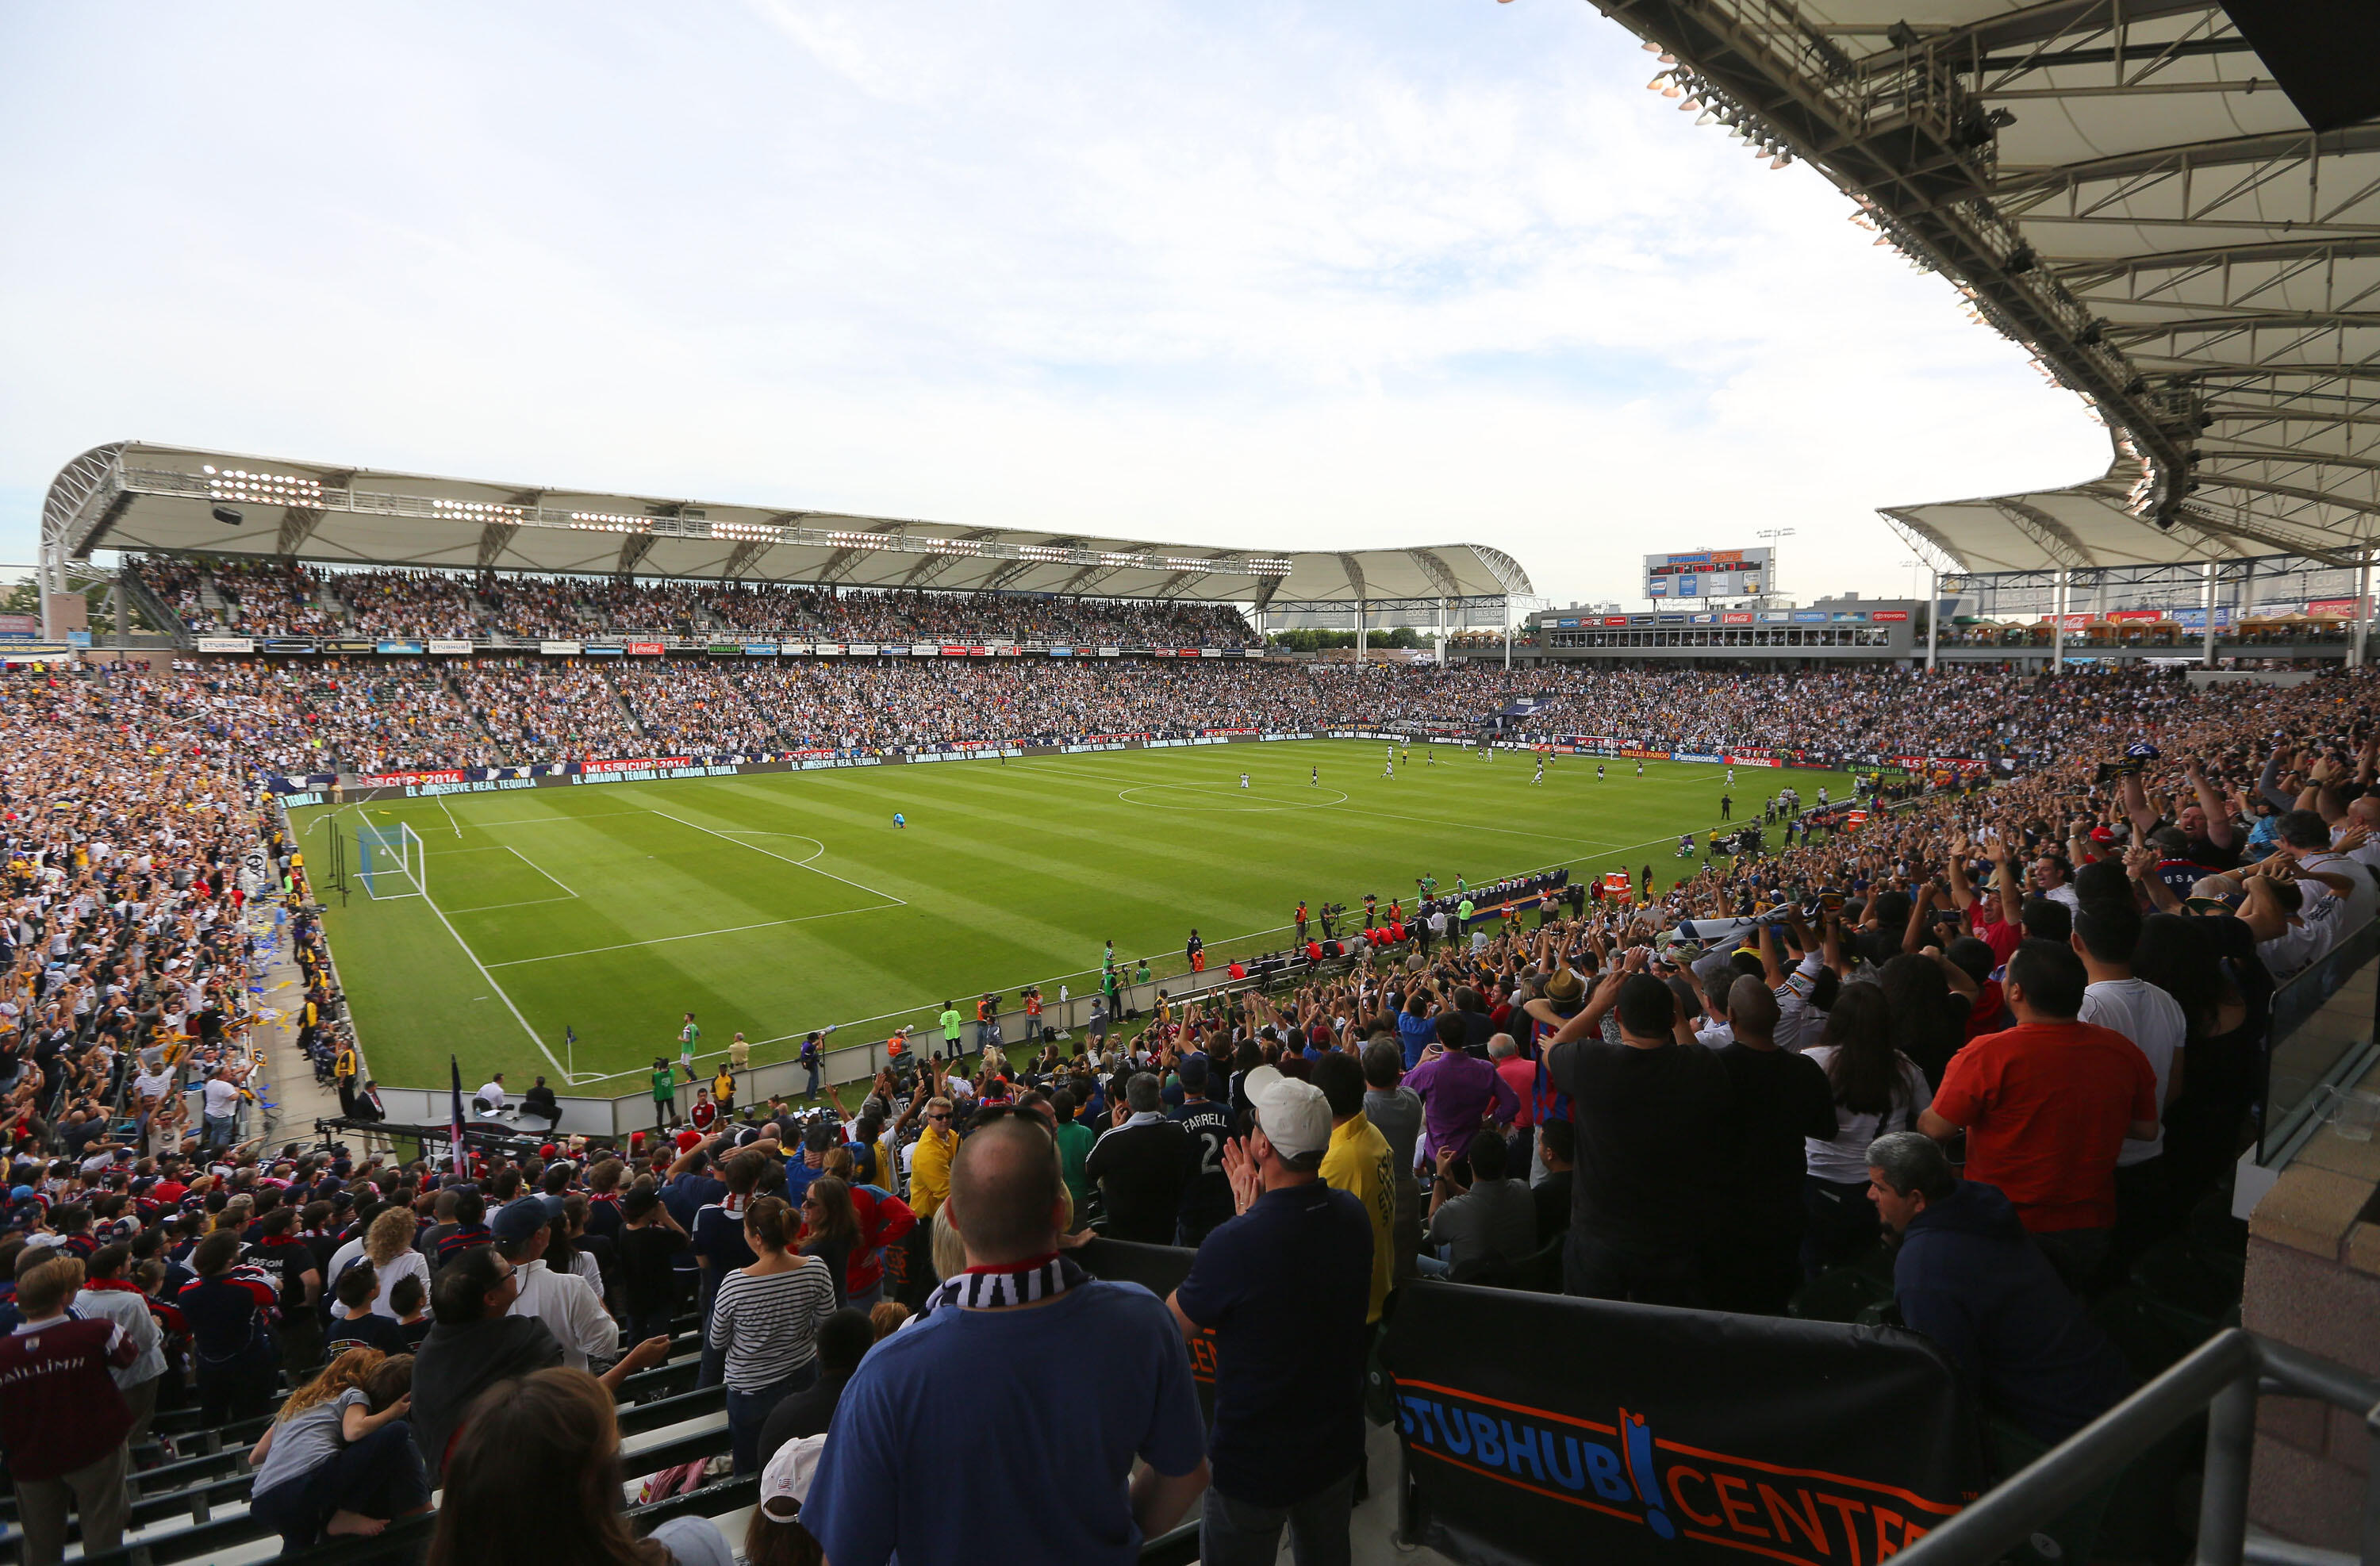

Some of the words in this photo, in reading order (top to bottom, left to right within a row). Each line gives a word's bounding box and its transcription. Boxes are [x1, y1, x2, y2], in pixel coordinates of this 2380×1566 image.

[2315, 575, 2344, 586] CUP
[967, 751, 975, 760] EL
[975, 749, 1000, 759] JIMADOR
[1061, 745, 1066, 754] EL
[906, 755, 913, 764] EL
[915, 754, 942, 763] JIMADOR
[942, 751, 966, 762] TEQUILA
[1674, 753, 1719, 763] Panasonic
[585, 763, 612, 773] MLS
[792, 762, 800, 771] EL
[837, 758, 854, 767] REAL
[854, 757, 881, 766] TEQUILA
[572, 774, 582, 785] EL
[584, 772, 622, 784] JIMADOR
[624, 770, 658, 781] TEQUILA
[659, 769, 670, 779] EL
[670, 767, 706, 778] JIMADOR
[707, 765, 739, 777] TEQUILA
[1858, 766, 1904, 775] HERBALIFE
[426, 773, 459, 785] 2014
[405, 785, 419, 797] EL
[473, 779, 497, 793] REAL
[498, 777, 538, 791] TEQUILA
[1182, 1113, 1228, 1134] FARRELL
[1200, 1133, 1223, 1174] 2
